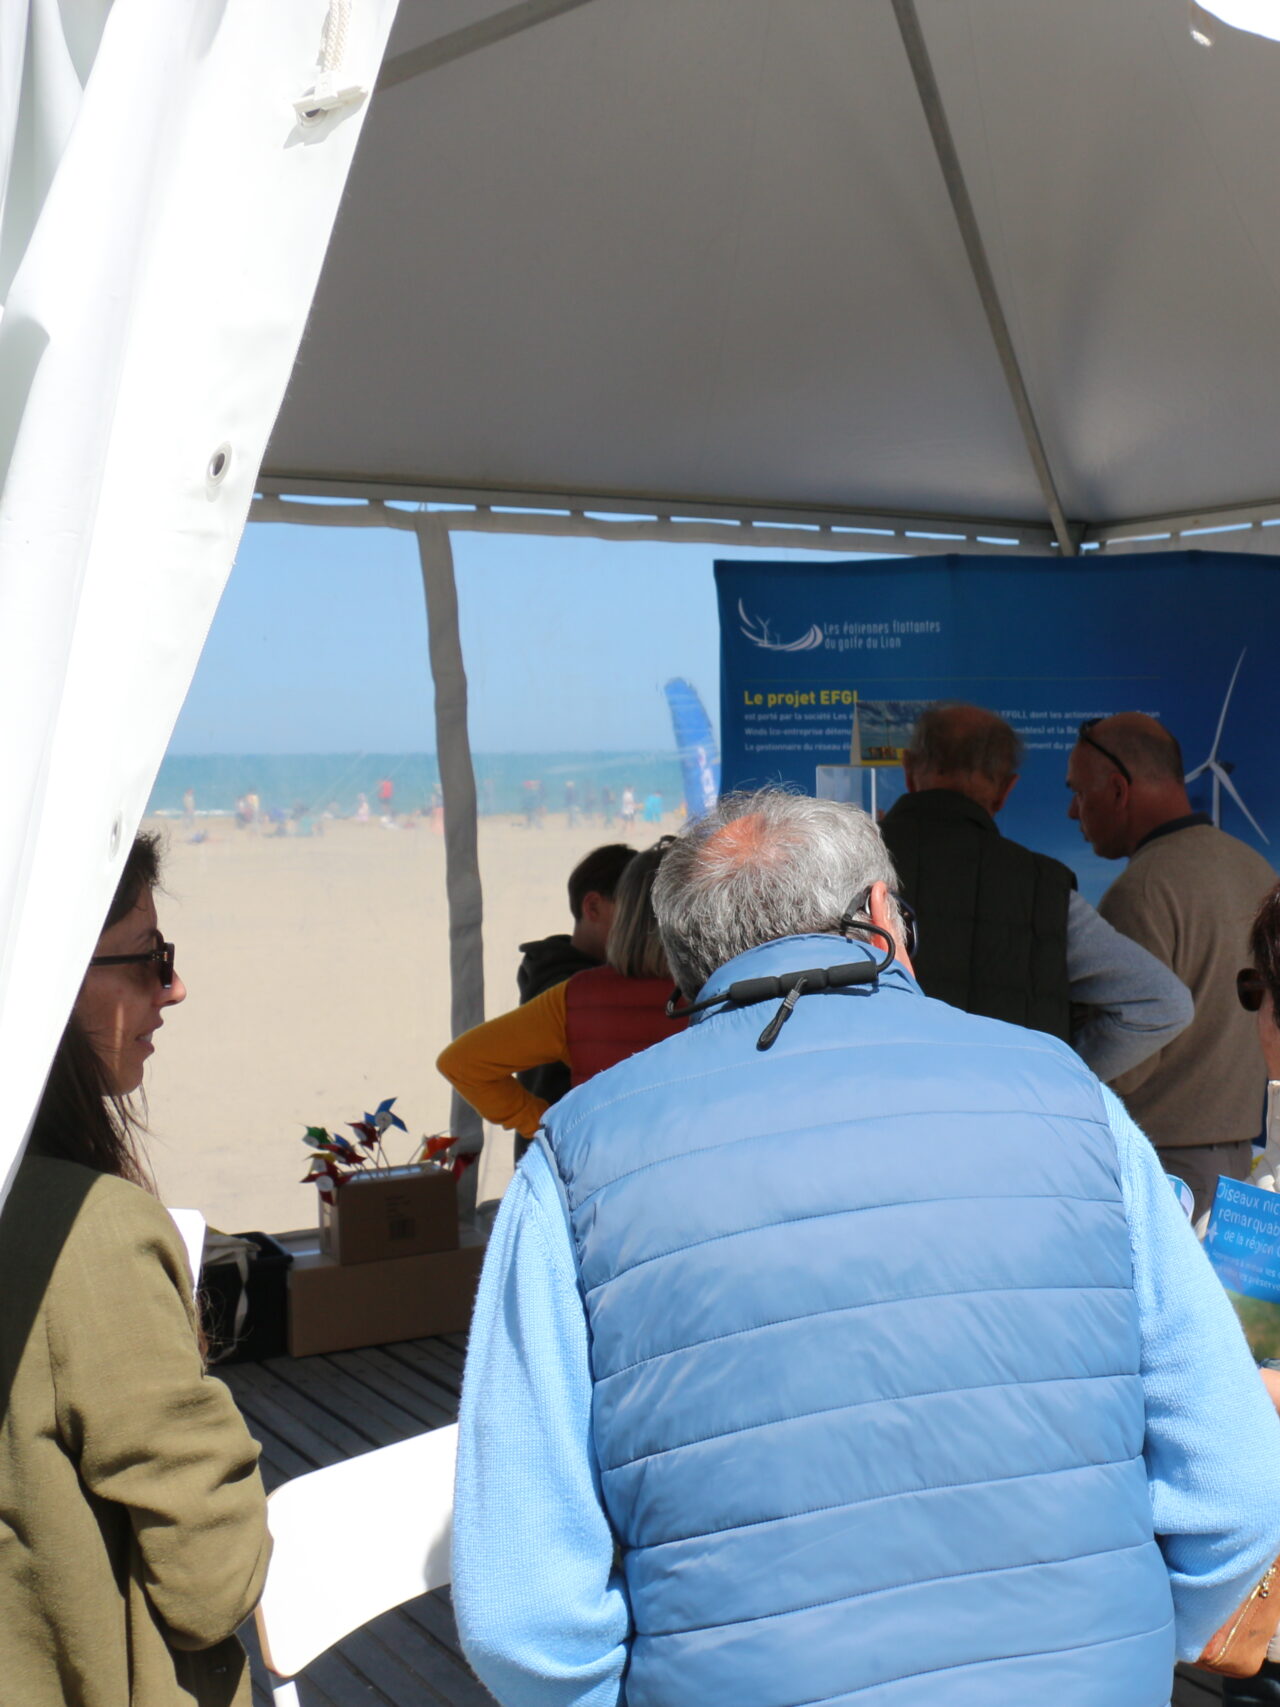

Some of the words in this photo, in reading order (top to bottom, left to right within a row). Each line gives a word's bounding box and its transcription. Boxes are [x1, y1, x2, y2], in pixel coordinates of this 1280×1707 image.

[824, 622, 840, 635] Les
[824, 637, 836, 649] du
[838, 636, 863, 652] golfe
[866, 636, 878, 649] du
[880, 635, 901, 649] Lion
[743, 690, 763, 705] Le
[767, 690, 816, 708] projet
[1216, 1182, 1260, 1209] Oiseaux
[1223, 1229, 1235, 1243] de
[1236, 1232, 1244, 1245] la
[1244, 1236, 1274, 1256] région
